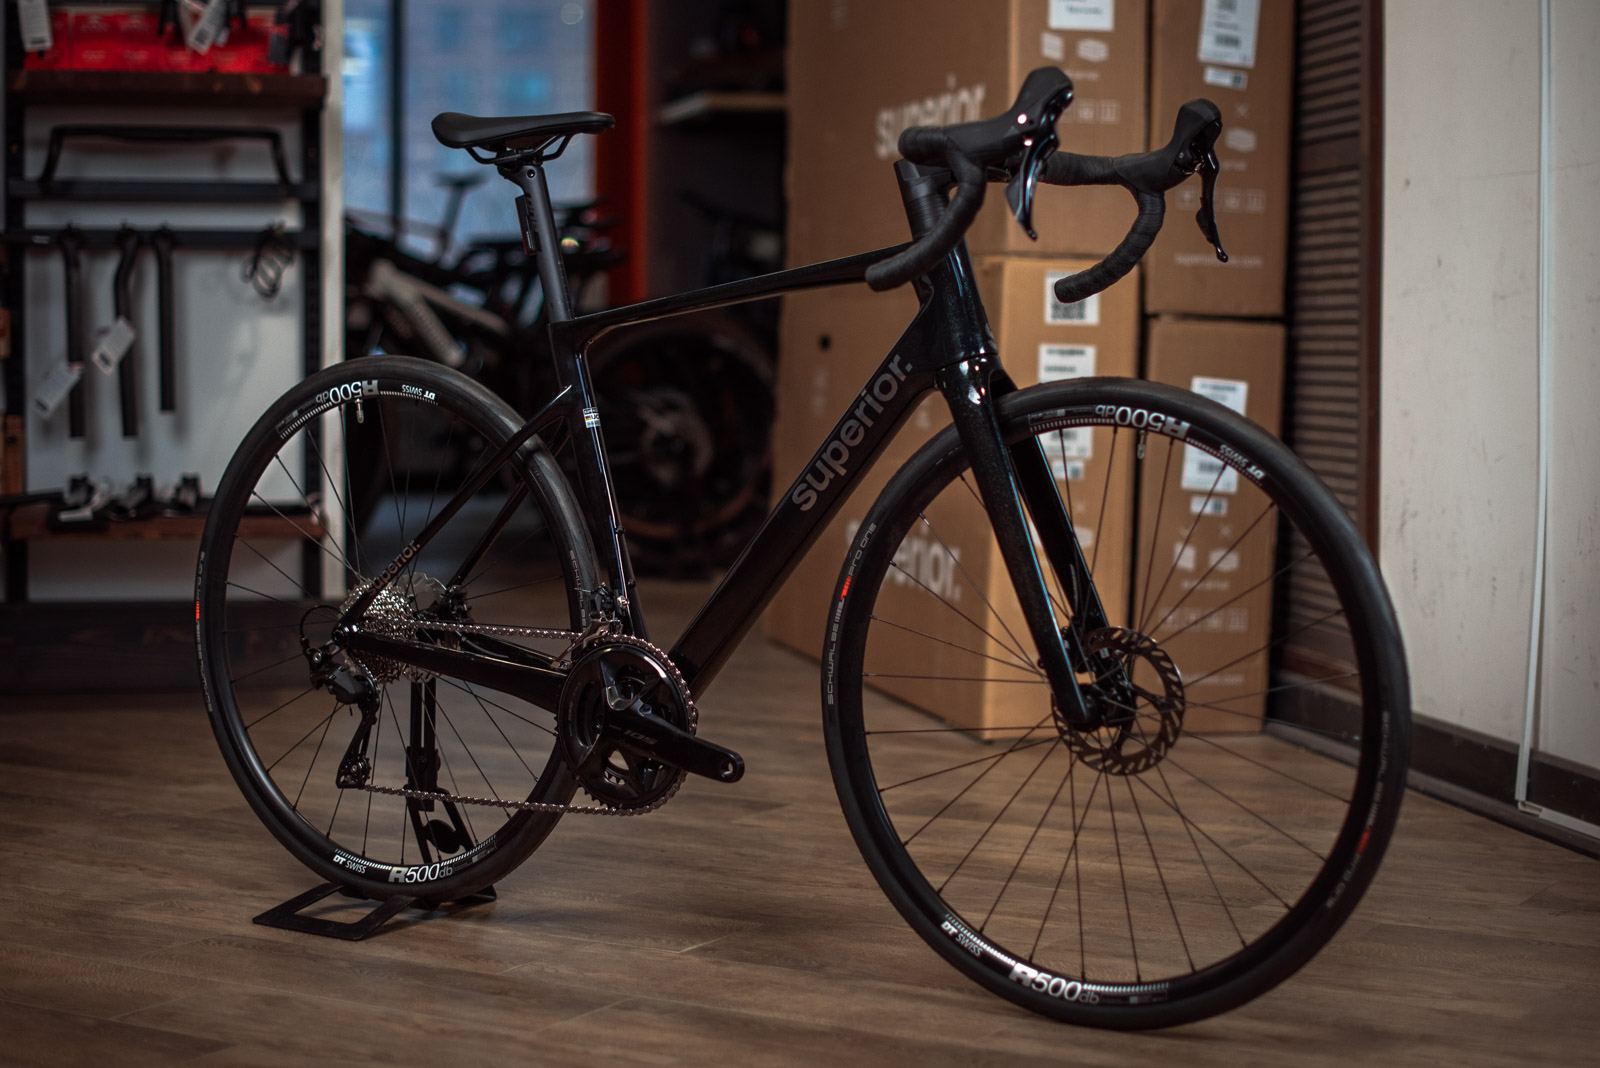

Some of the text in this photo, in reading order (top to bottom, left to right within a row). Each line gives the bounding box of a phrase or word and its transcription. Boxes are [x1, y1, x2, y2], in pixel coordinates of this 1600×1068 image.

[401, 384, 436, 400] DT SWISS
[792, 354, 913, 511] superior.
[1219, 444, 1266, 480] DT SWISS
[333, 854, 367, 874] DT SWISS
[941, 920, 984, 957] DT SWISS
